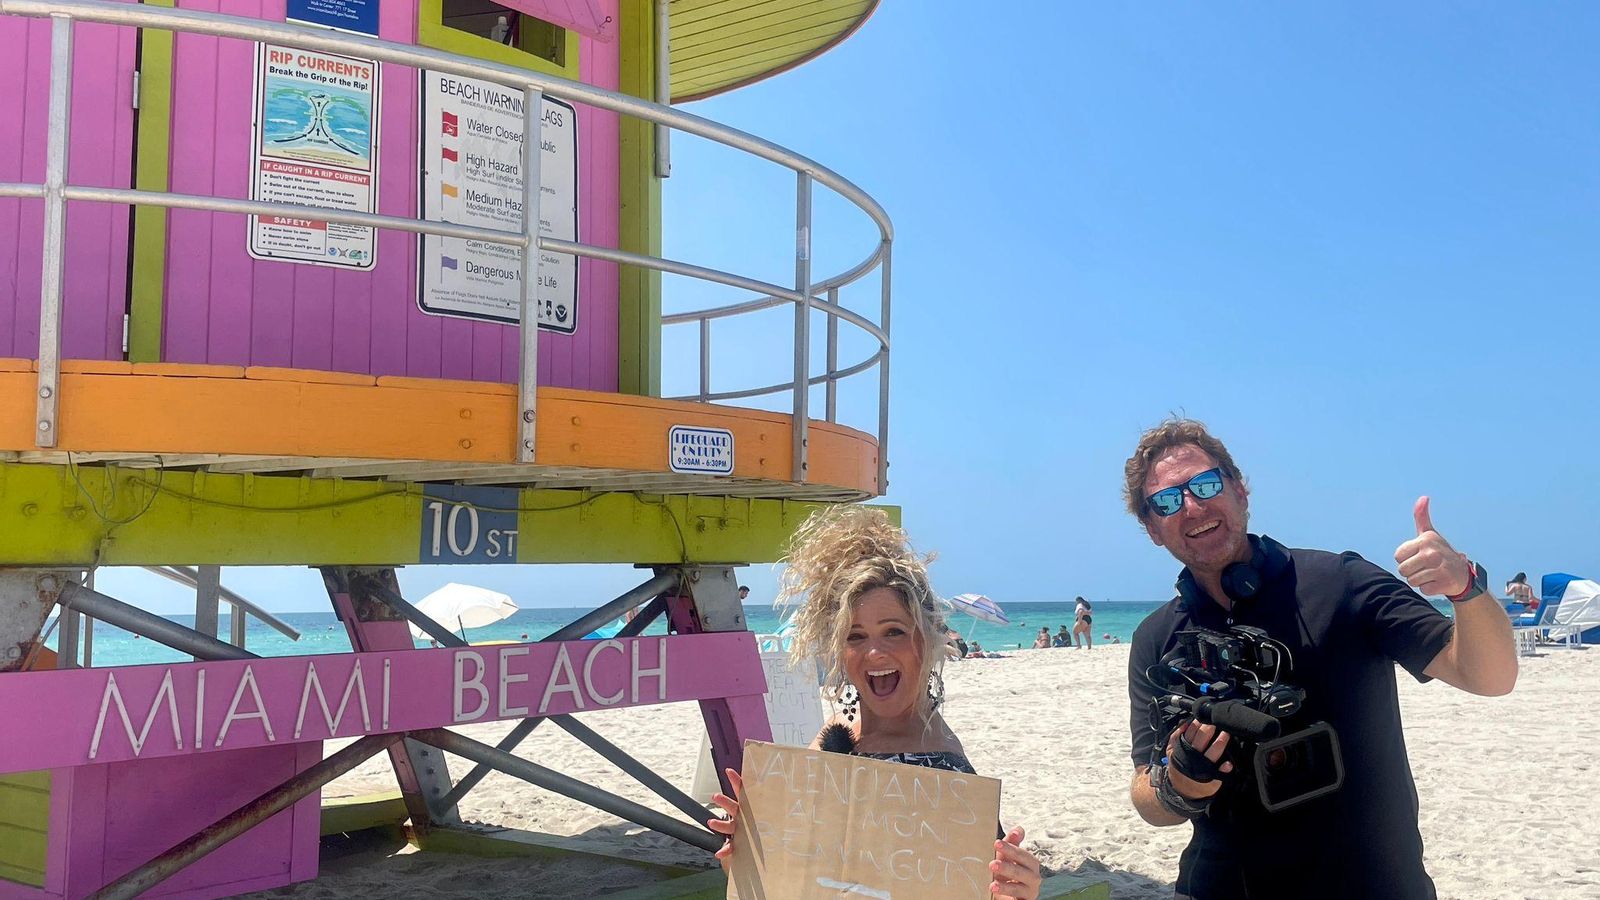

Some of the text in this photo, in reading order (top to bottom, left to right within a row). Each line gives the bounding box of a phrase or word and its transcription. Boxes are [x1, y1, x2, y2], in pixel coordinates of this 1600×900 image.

[270, 50, 369, 80] RIP CURRENTS
[269, 66, 368, 90] Break the Grip of the Rip!
[441, 78, 480, 102] BEACH
[483, 88, 524, 113] WARNIN
[466, 118, 493, 135] Water
[495, 125, 524, 143] Closed
[540, 140, 556, 154] ublic
[263, 162, 270, 170] IF
[272, 164, 303, 174] CAUGHT
[305, 167, 312, 175] IN
[321, 169, 333, 178] RIP
[334, 172, 367, 183] CURRENT
[466, 152, 518, 175] High Hazard
[466, 167, 481, 176] High
[482, 170, 495, 179] Surf
[466, 189, 522, 212] Medium Haz
[466, 202, 496, 214] Moderate
[273, 217, 313, 227] SAFETY
[466, 239, 482, 249] Calm
[541, 254, 560, 265] Caution
[466, 261, 514, 280] Dangerous
[544, 275, 558, 288] Life
[675, 433, 729, 447] LIFEGUARD
[682, 445, 723, 457] ON DUTY
[677, 457, 701, 466] 9:30AM
[705, 460, 727, 468] 6:30PM
[428, 501, 519, 558] 10 ST
[89, 637, 669, 759] MIAMI BEACH
[745, 752, 977, 826] VALENCIANS
[788, 799, 824, 825] AL
